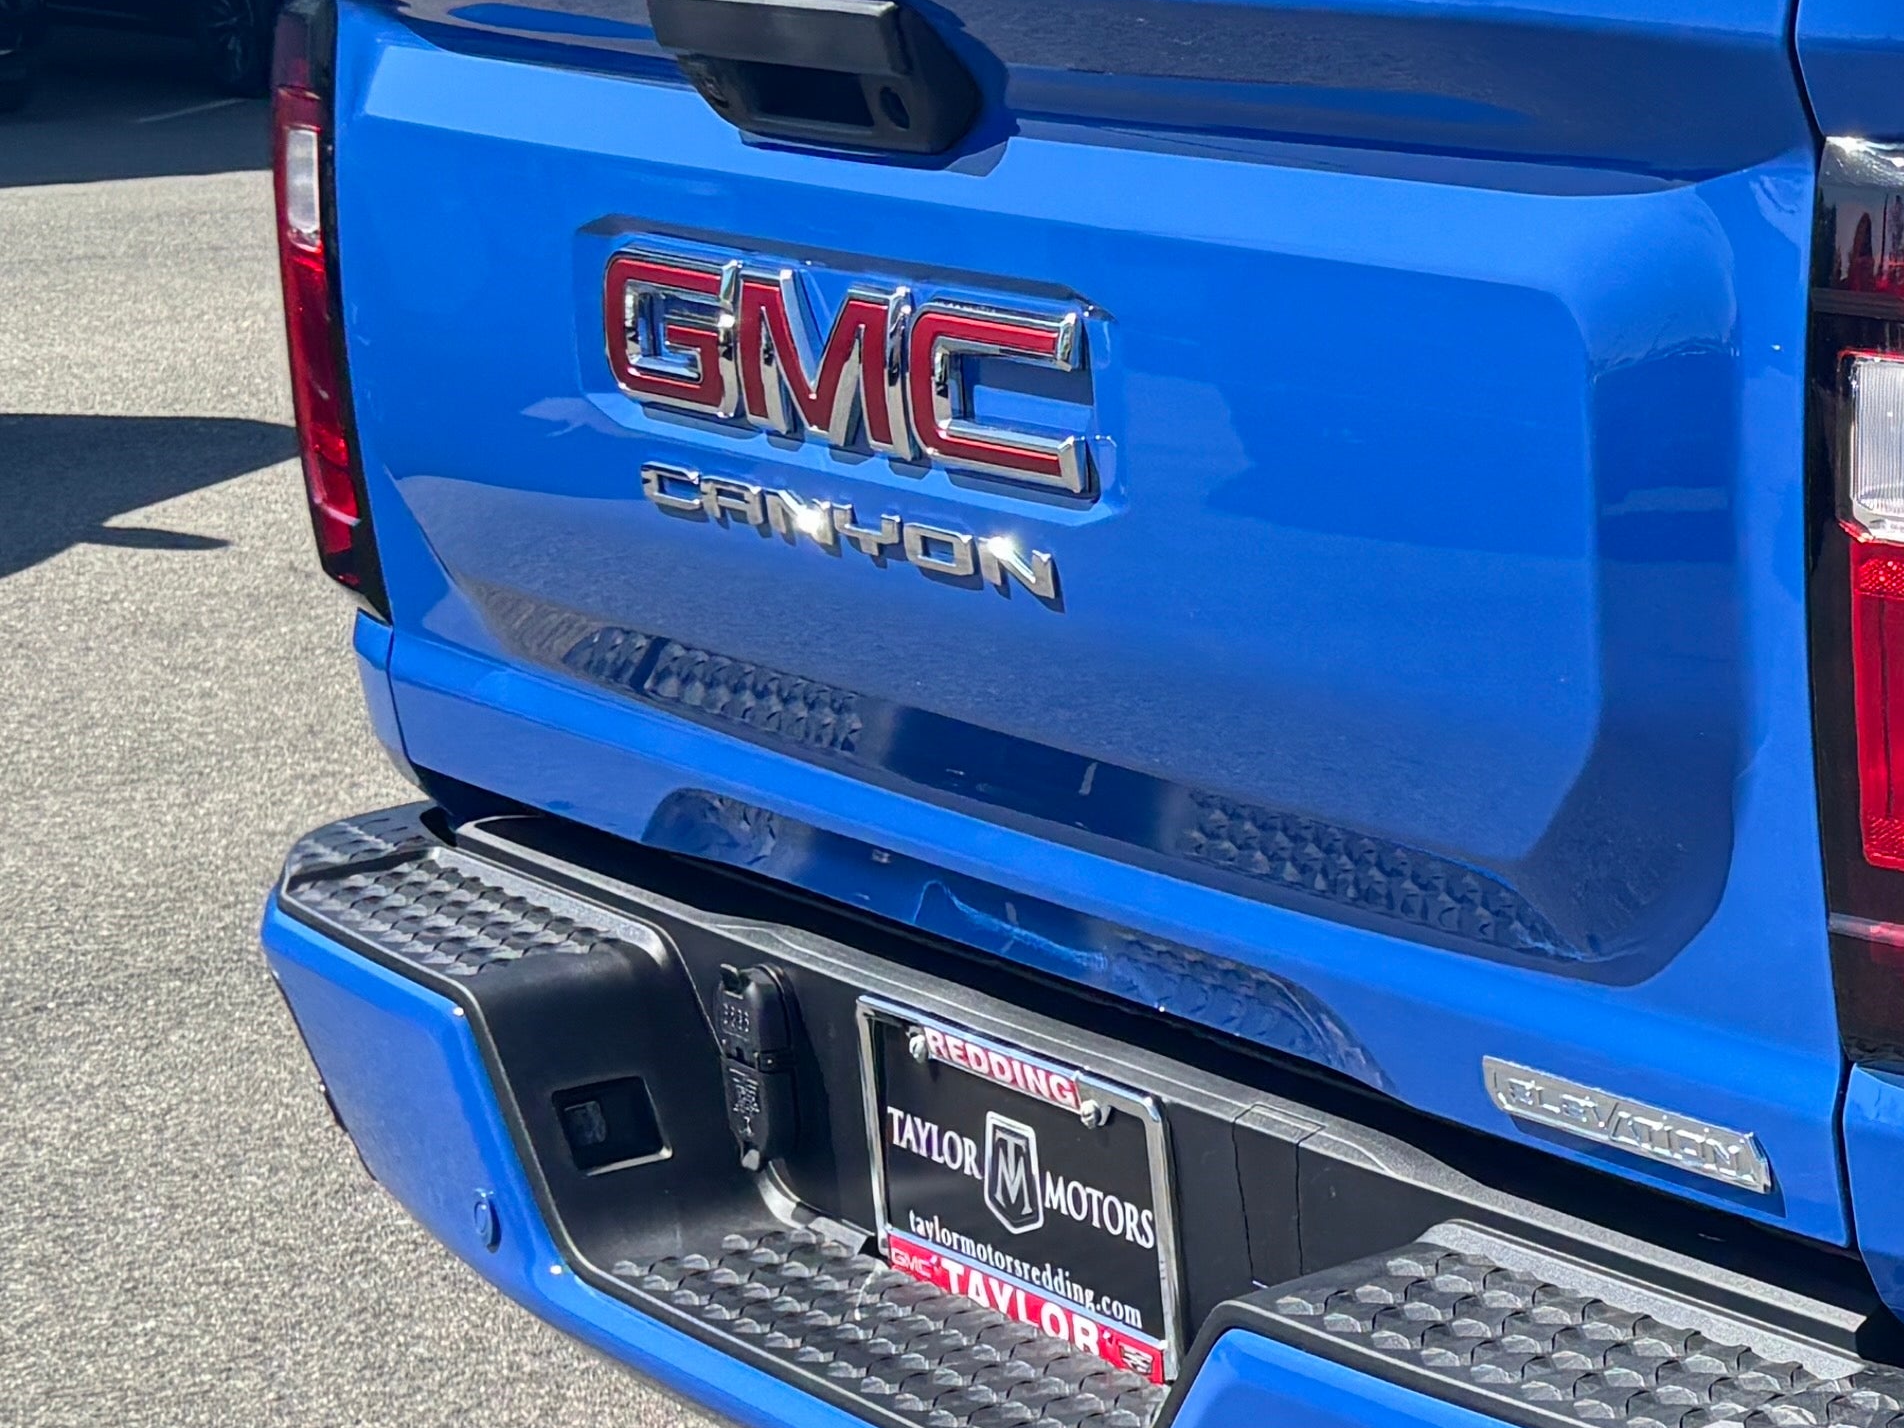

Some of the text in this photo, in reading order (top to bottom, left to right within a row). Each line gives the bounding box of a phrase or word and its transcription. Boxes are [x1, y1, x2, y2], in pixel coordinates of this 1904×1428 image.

[603, 246, 1093, 498] GMC
[640, 461, 1058, 599] CANYON
[924, 1026, 1079, 1108] REDDING
[886, 1105, 984, 1181] TAYLOR
[1043, 1170, 1155, 1250] MOTORS
[1505, 1075, 1757, 1185] ELEVATION
[908, 1208, 1144, 1330] taylormotorsredding.com
[941, 1257, 1101, 1357] TAYLOR
